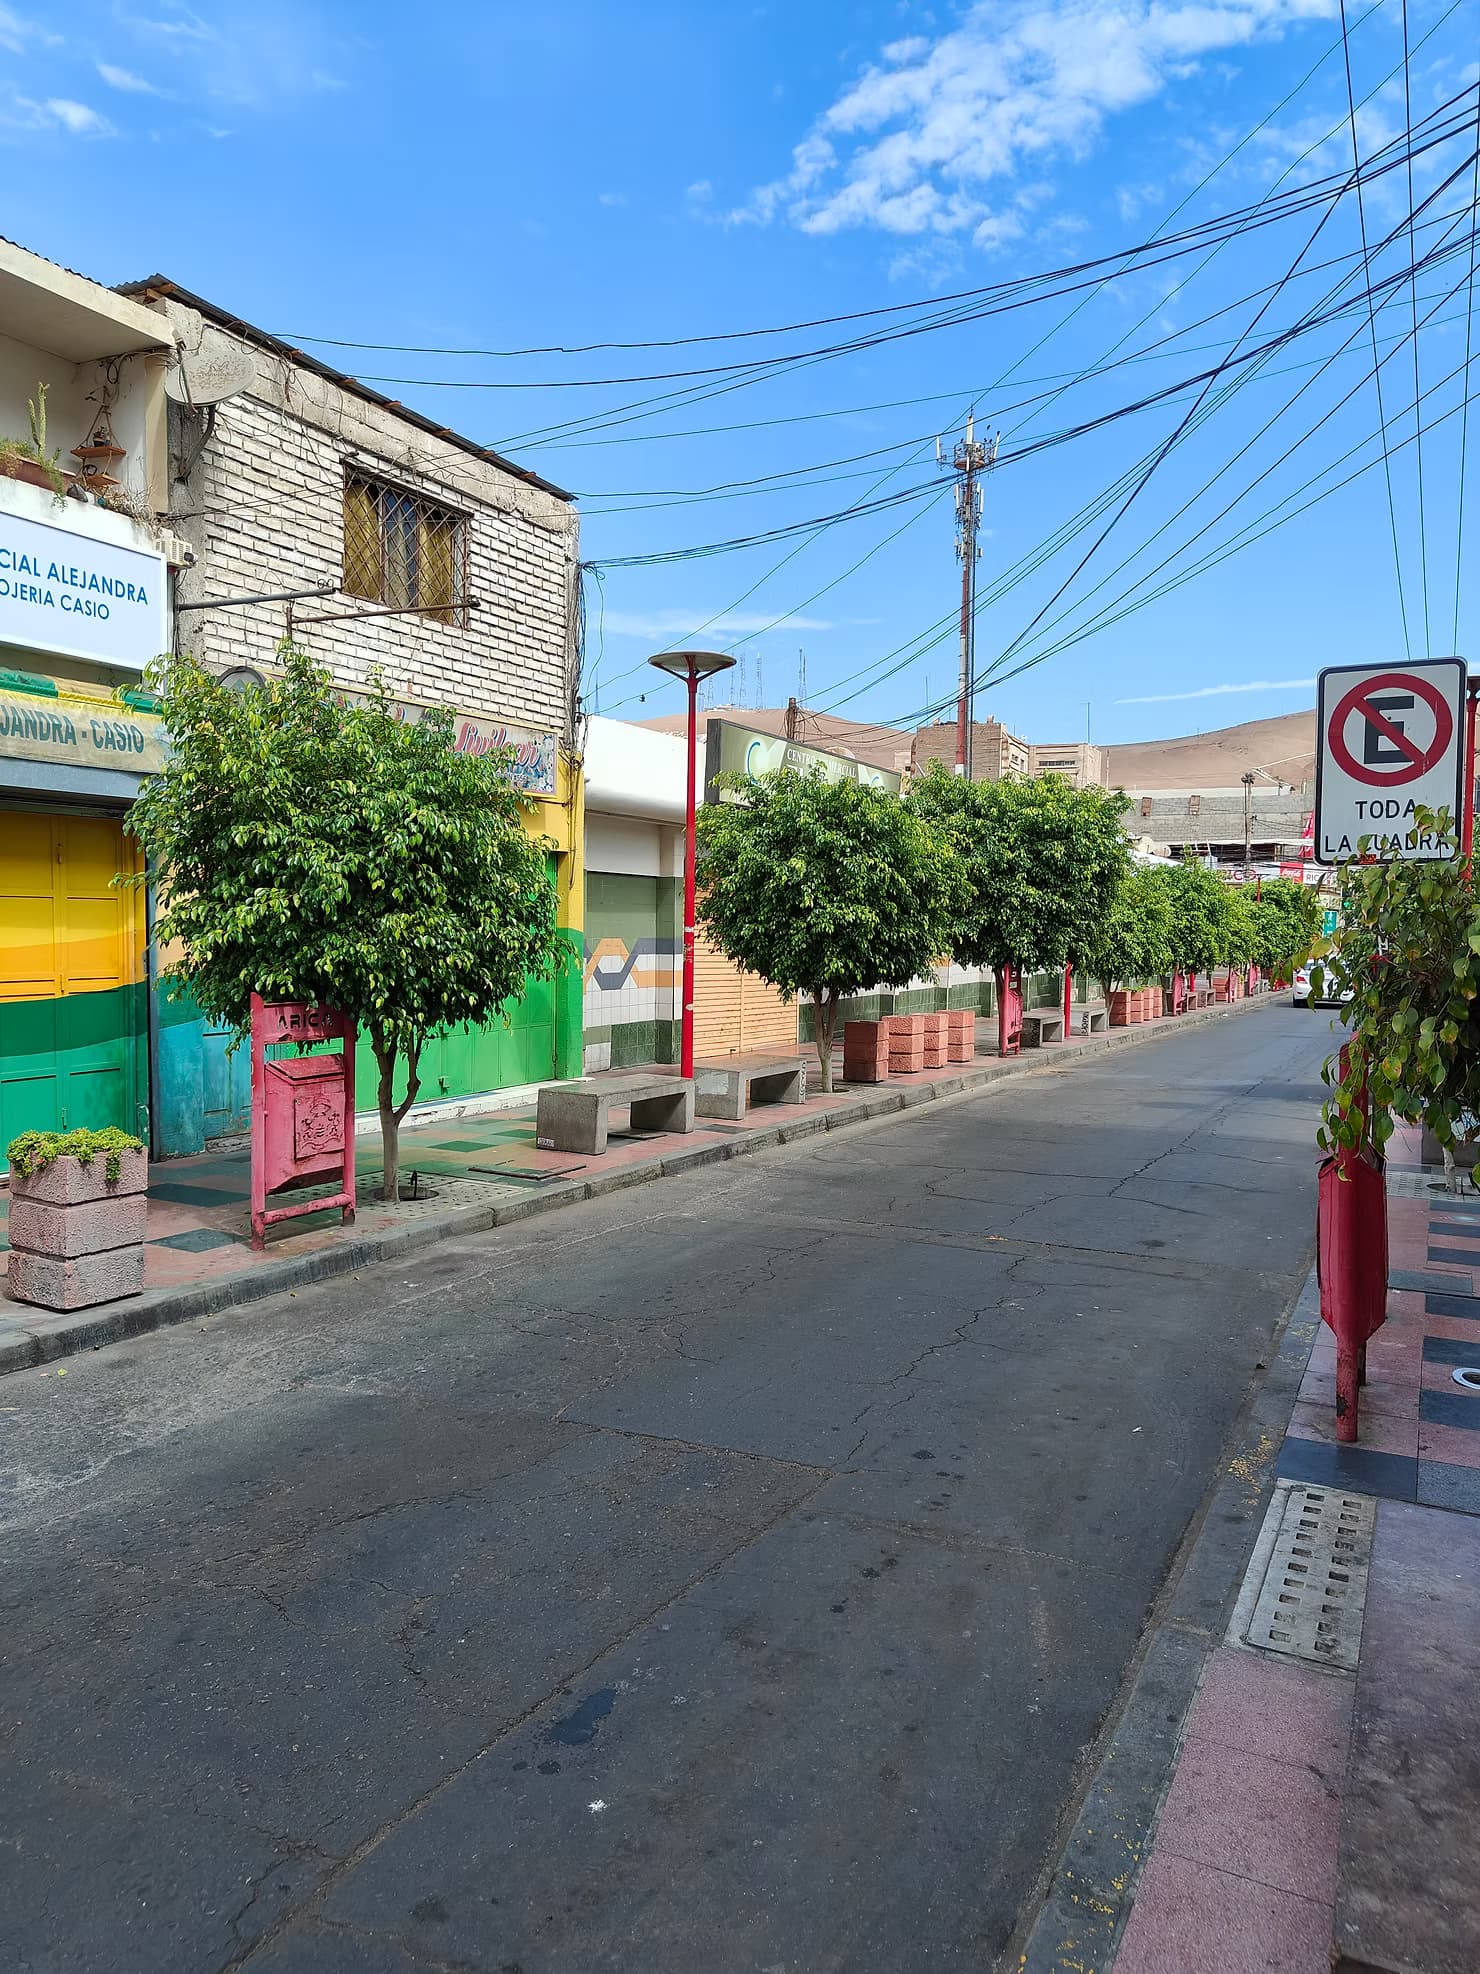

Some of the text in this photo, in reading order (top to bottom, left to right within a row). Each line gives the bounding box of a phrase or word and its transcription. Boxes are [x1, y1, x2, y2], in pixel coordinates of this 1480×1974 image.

[0, 548, 149, 606] CIAL ALEJANDRA
[0, 578, 110, 620] OJERIA CASIO
[0, 704, 77, 746] JANDRA
[89, 719, 145, 754] CASIO
[1355, 799, 1416, 820] TODA
[1325, 834, 1352, 853] LA
